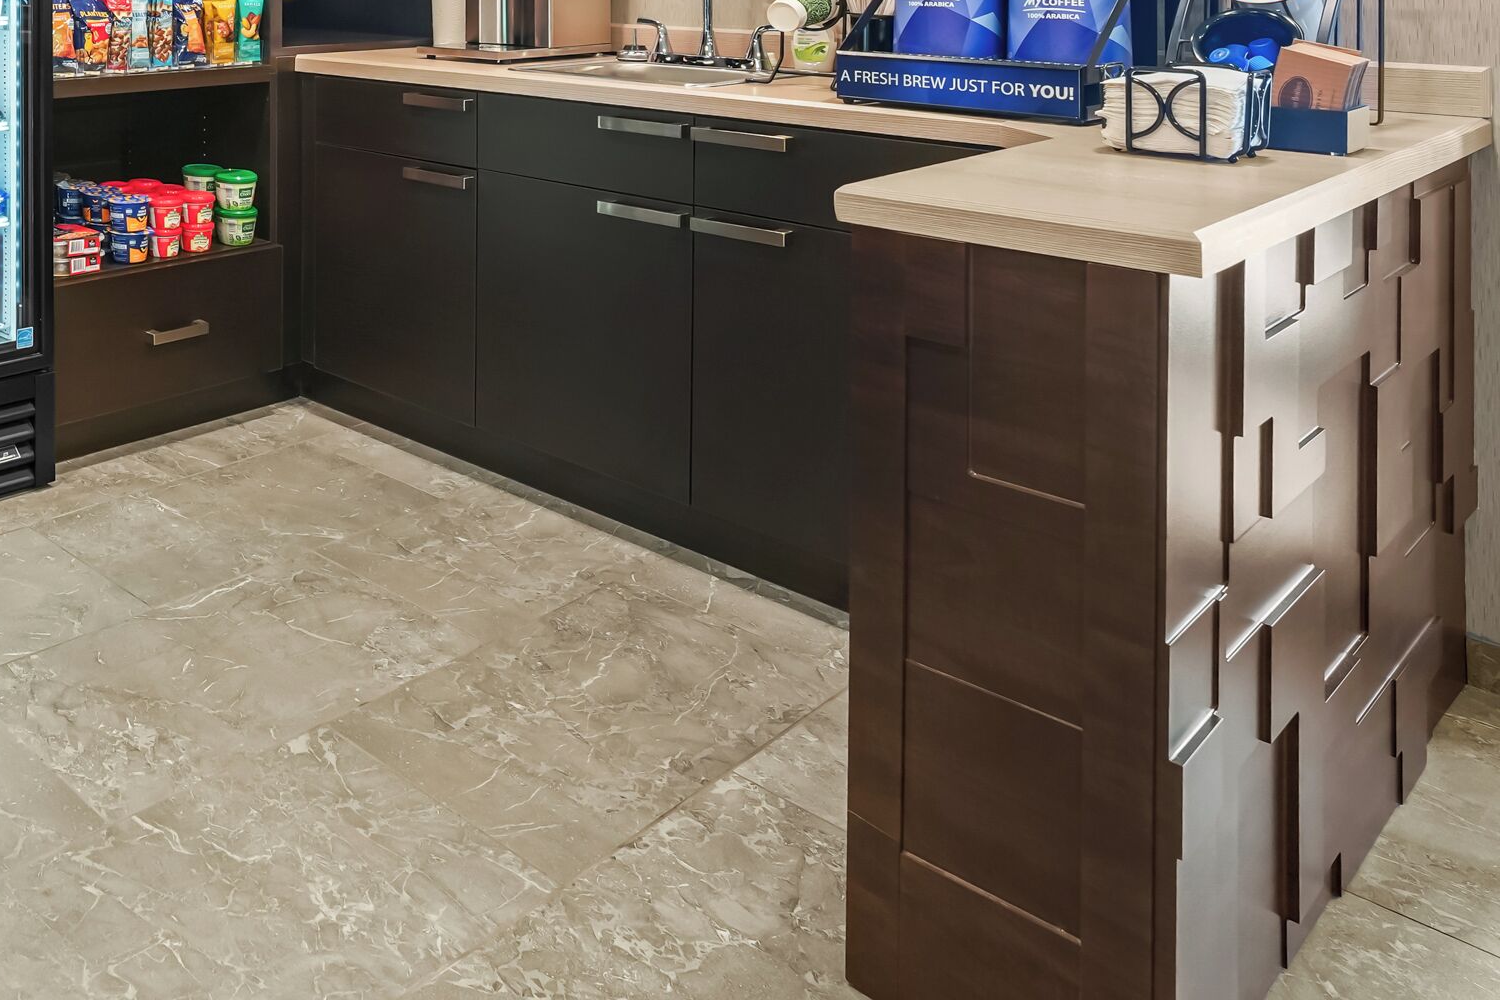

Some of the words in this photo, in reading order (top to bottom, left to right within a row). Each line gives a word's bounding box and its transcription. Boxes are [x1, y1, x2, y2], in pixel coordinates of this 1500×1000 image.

[841, 69, 851, 82] A
[854, 70, 899, 86] FRESH
[903, 74, 946, 90] BREW
[949, 77, 988, 94] JUST
[992, 81, 1025, 97] FOR
[1028, 83, 1075, 101] YOU!
